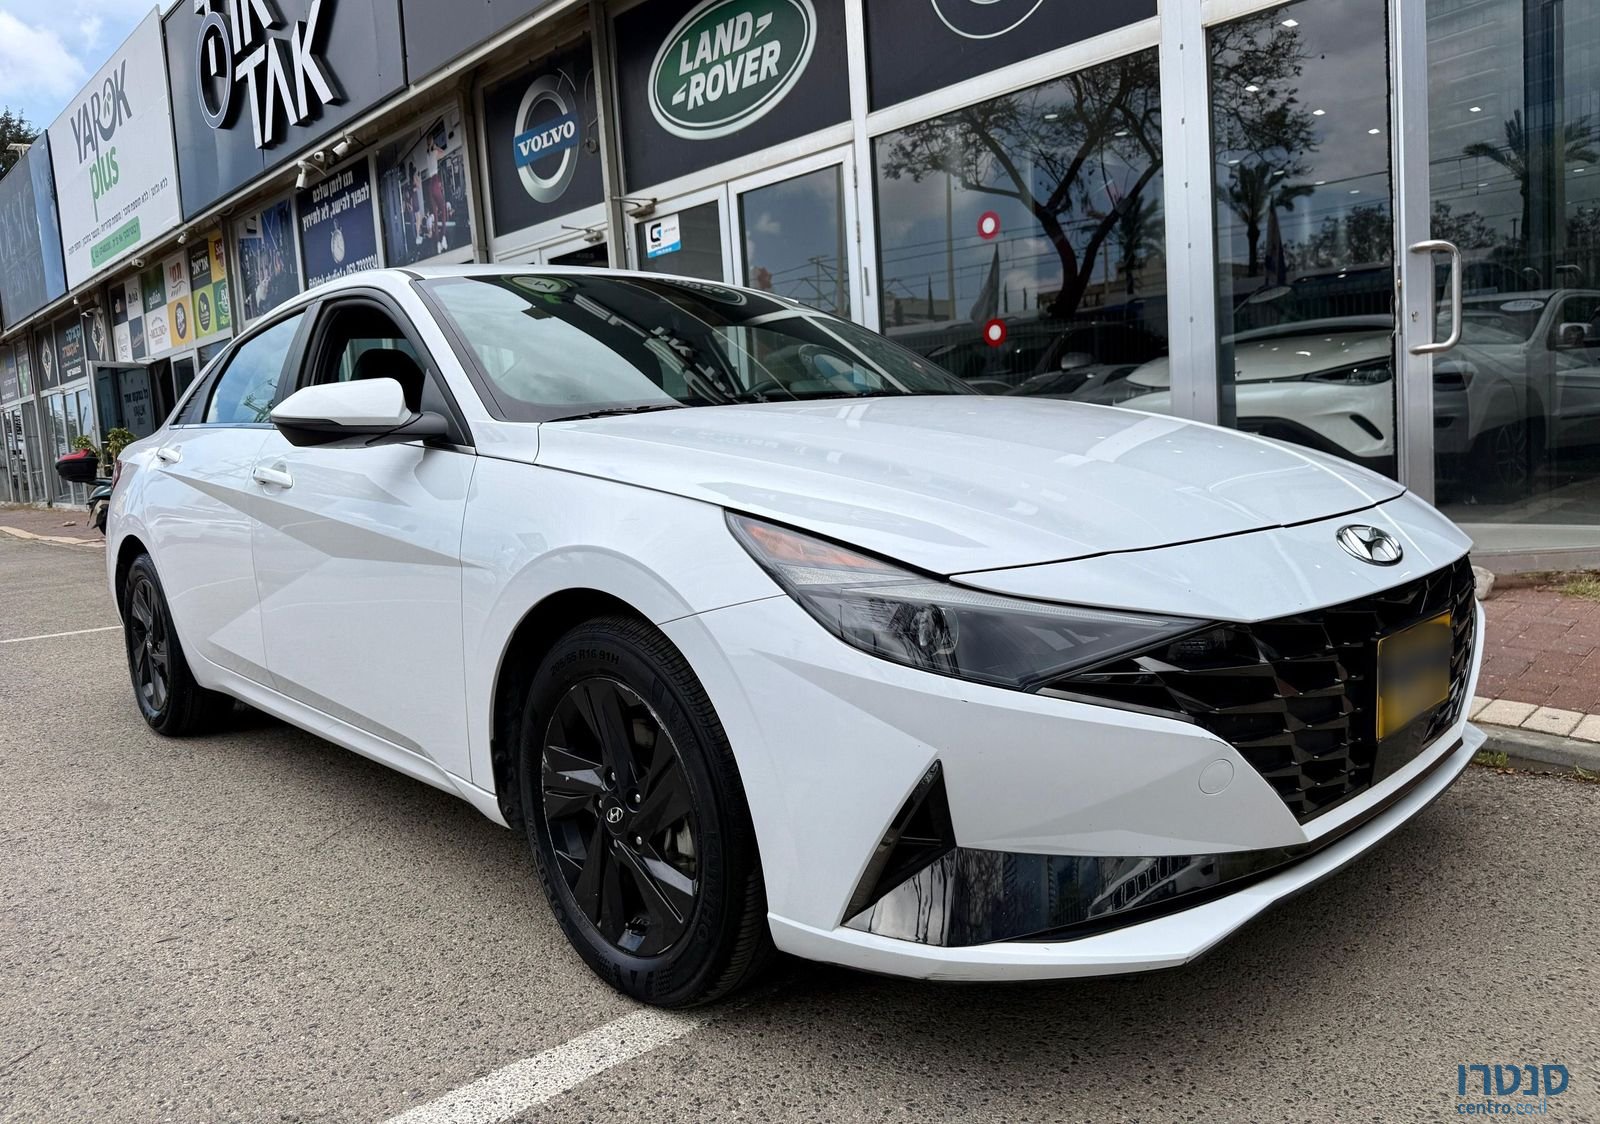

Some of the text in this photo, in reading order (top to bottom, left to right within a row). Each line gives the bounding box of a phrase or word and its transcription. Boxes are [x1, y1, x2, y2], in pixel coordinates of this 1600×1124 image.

[679, 11, 753, 76] LAND
[235, 0, 334, 149] TAK
[687, 39, 781, 111] ROVER
[70, 59, 132, 164] YAROK
[517, 120, 575, 157] VOLVO
[89, 146, 119, 222] plus
[312, 184, 329, 203] שלכם
[350, 181, 370, 209] להפוך
[320, 202, 329, 221] לא
[599, 649, 620, 665] 91H
